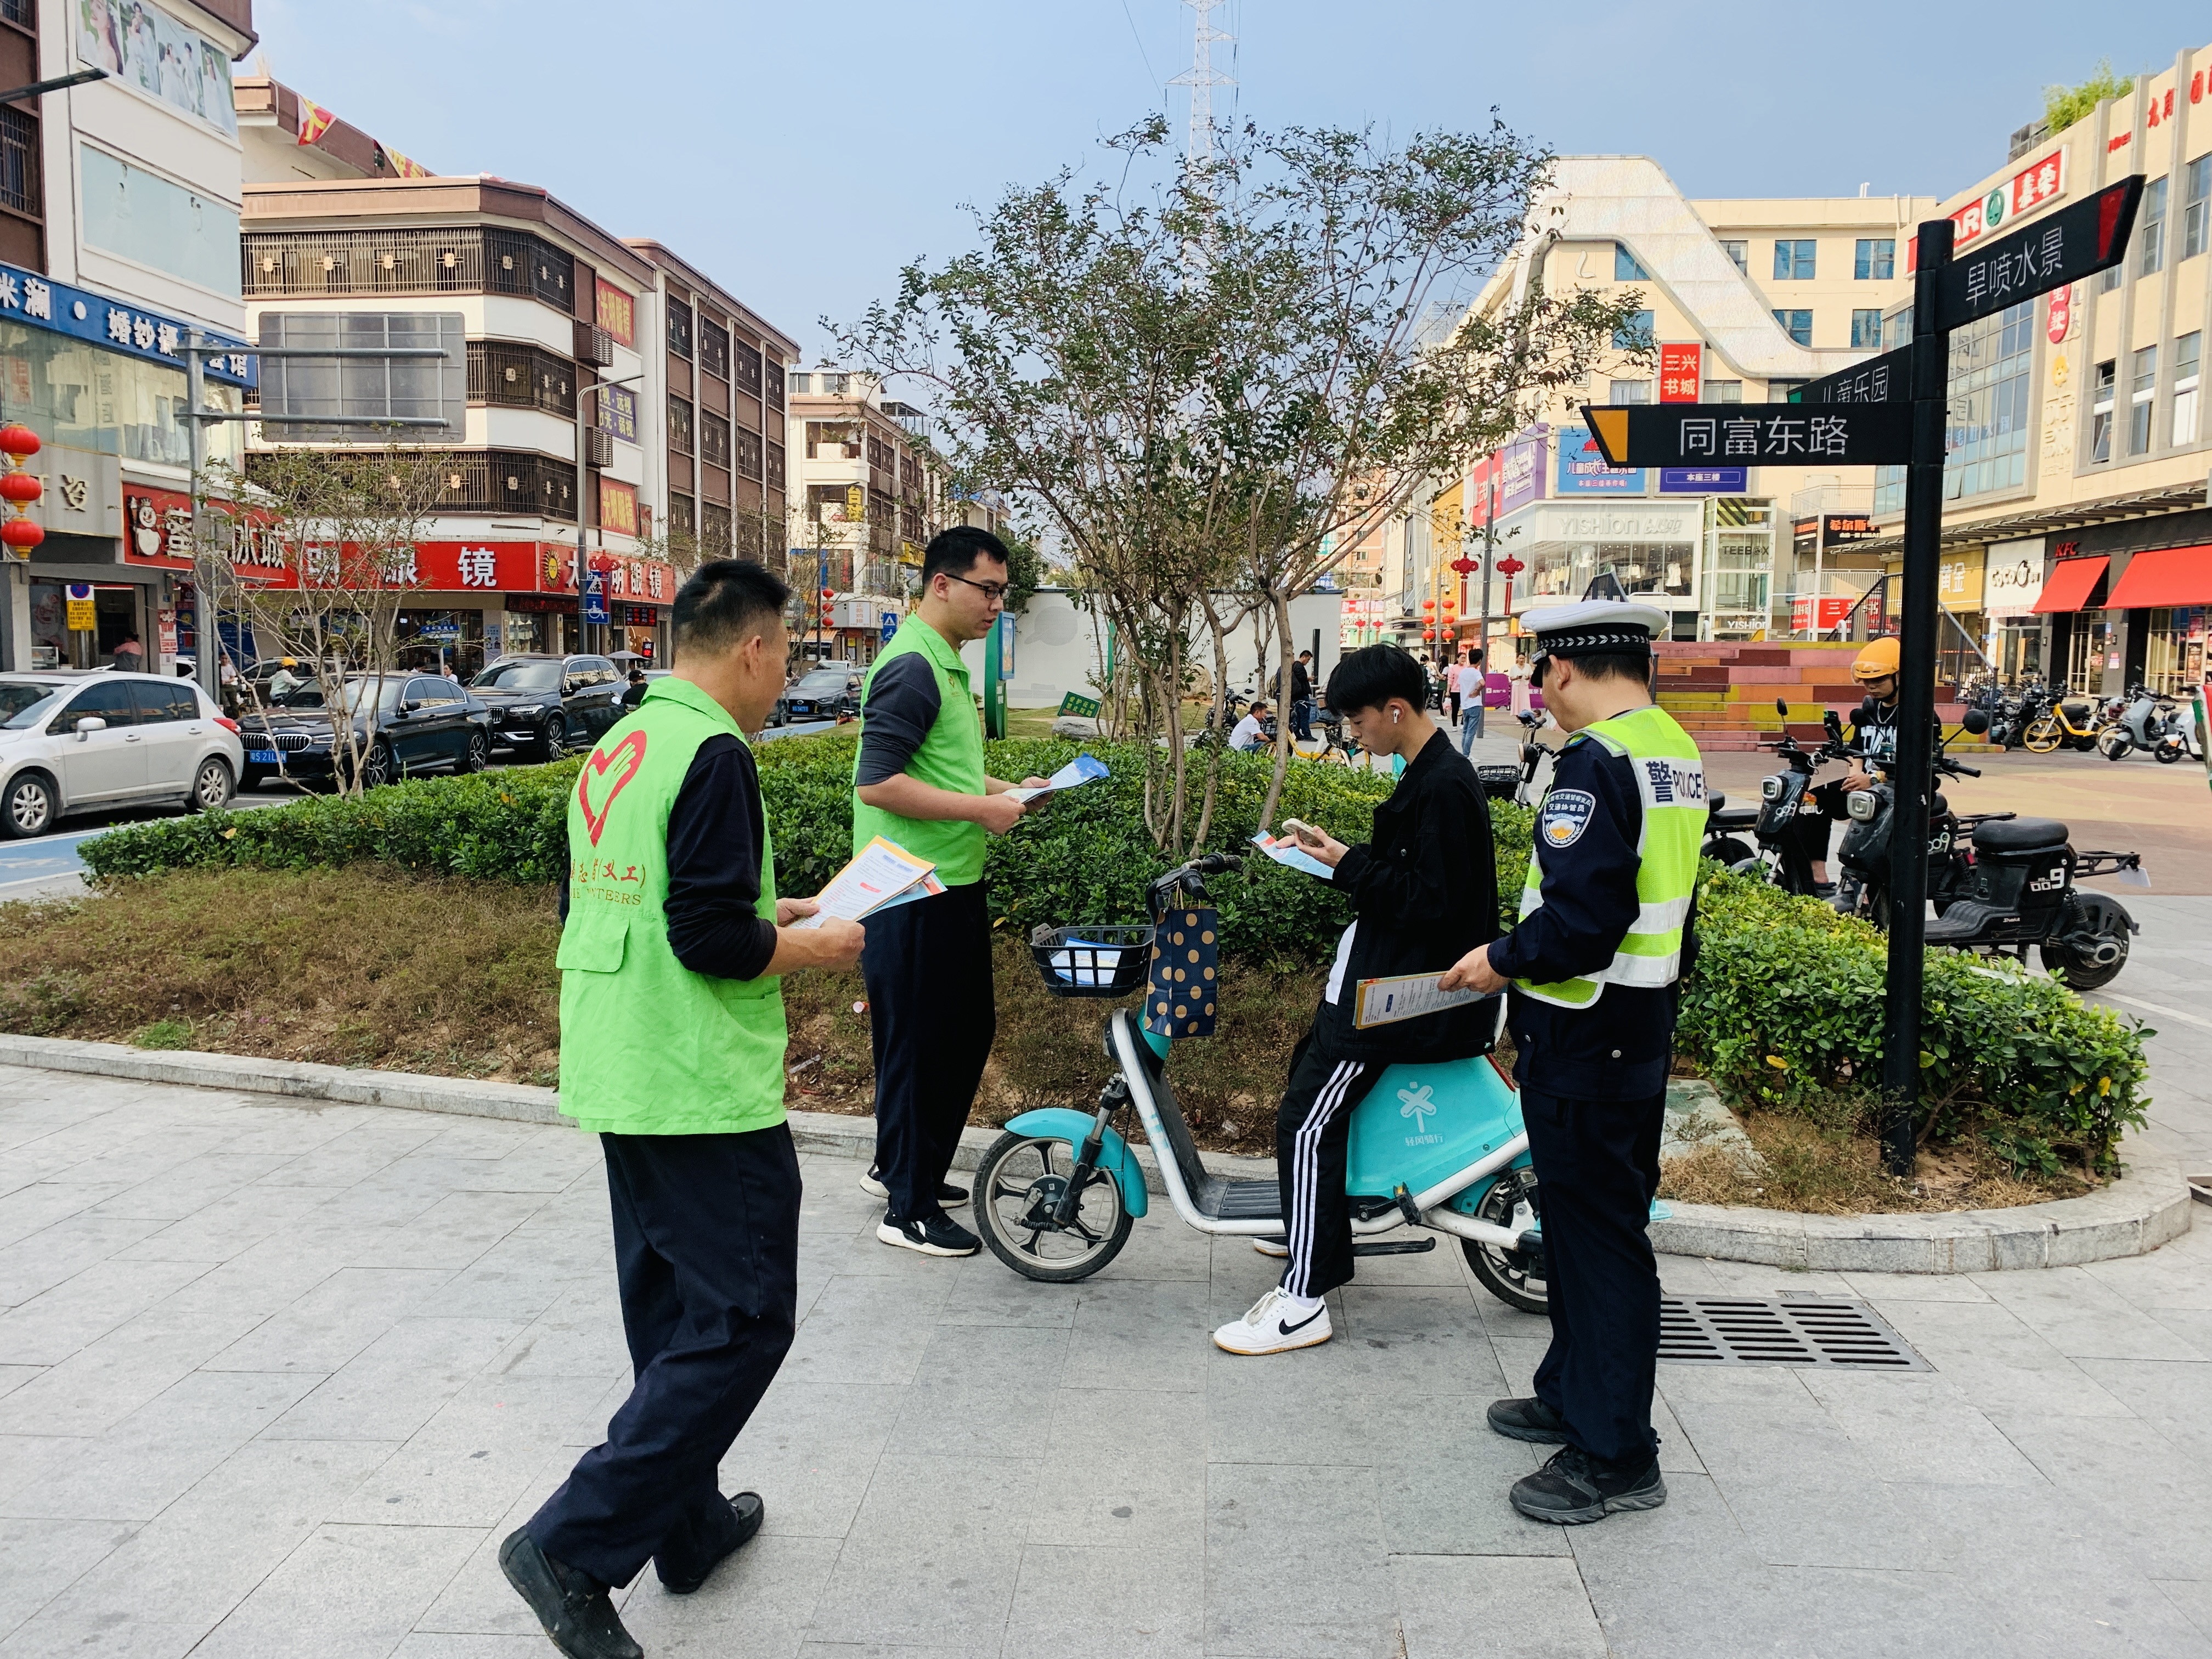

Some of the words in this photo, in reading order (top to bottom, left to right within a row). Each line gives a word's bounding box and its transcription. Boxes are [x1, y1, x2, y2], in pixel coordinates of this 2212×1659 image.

[1966, 226, 2064, 306] 旱喷水景
[1664, 354, 1697, 371] 三兴
[1663, 378, 1696, 395] 书城
[1680, 415, 1849, 456] 同富东路
[1686, 473, 1721, 482] 本座三楼
[2055, 542, 2079, 557] KFC
[1646, 760, 1673, 802] 警
